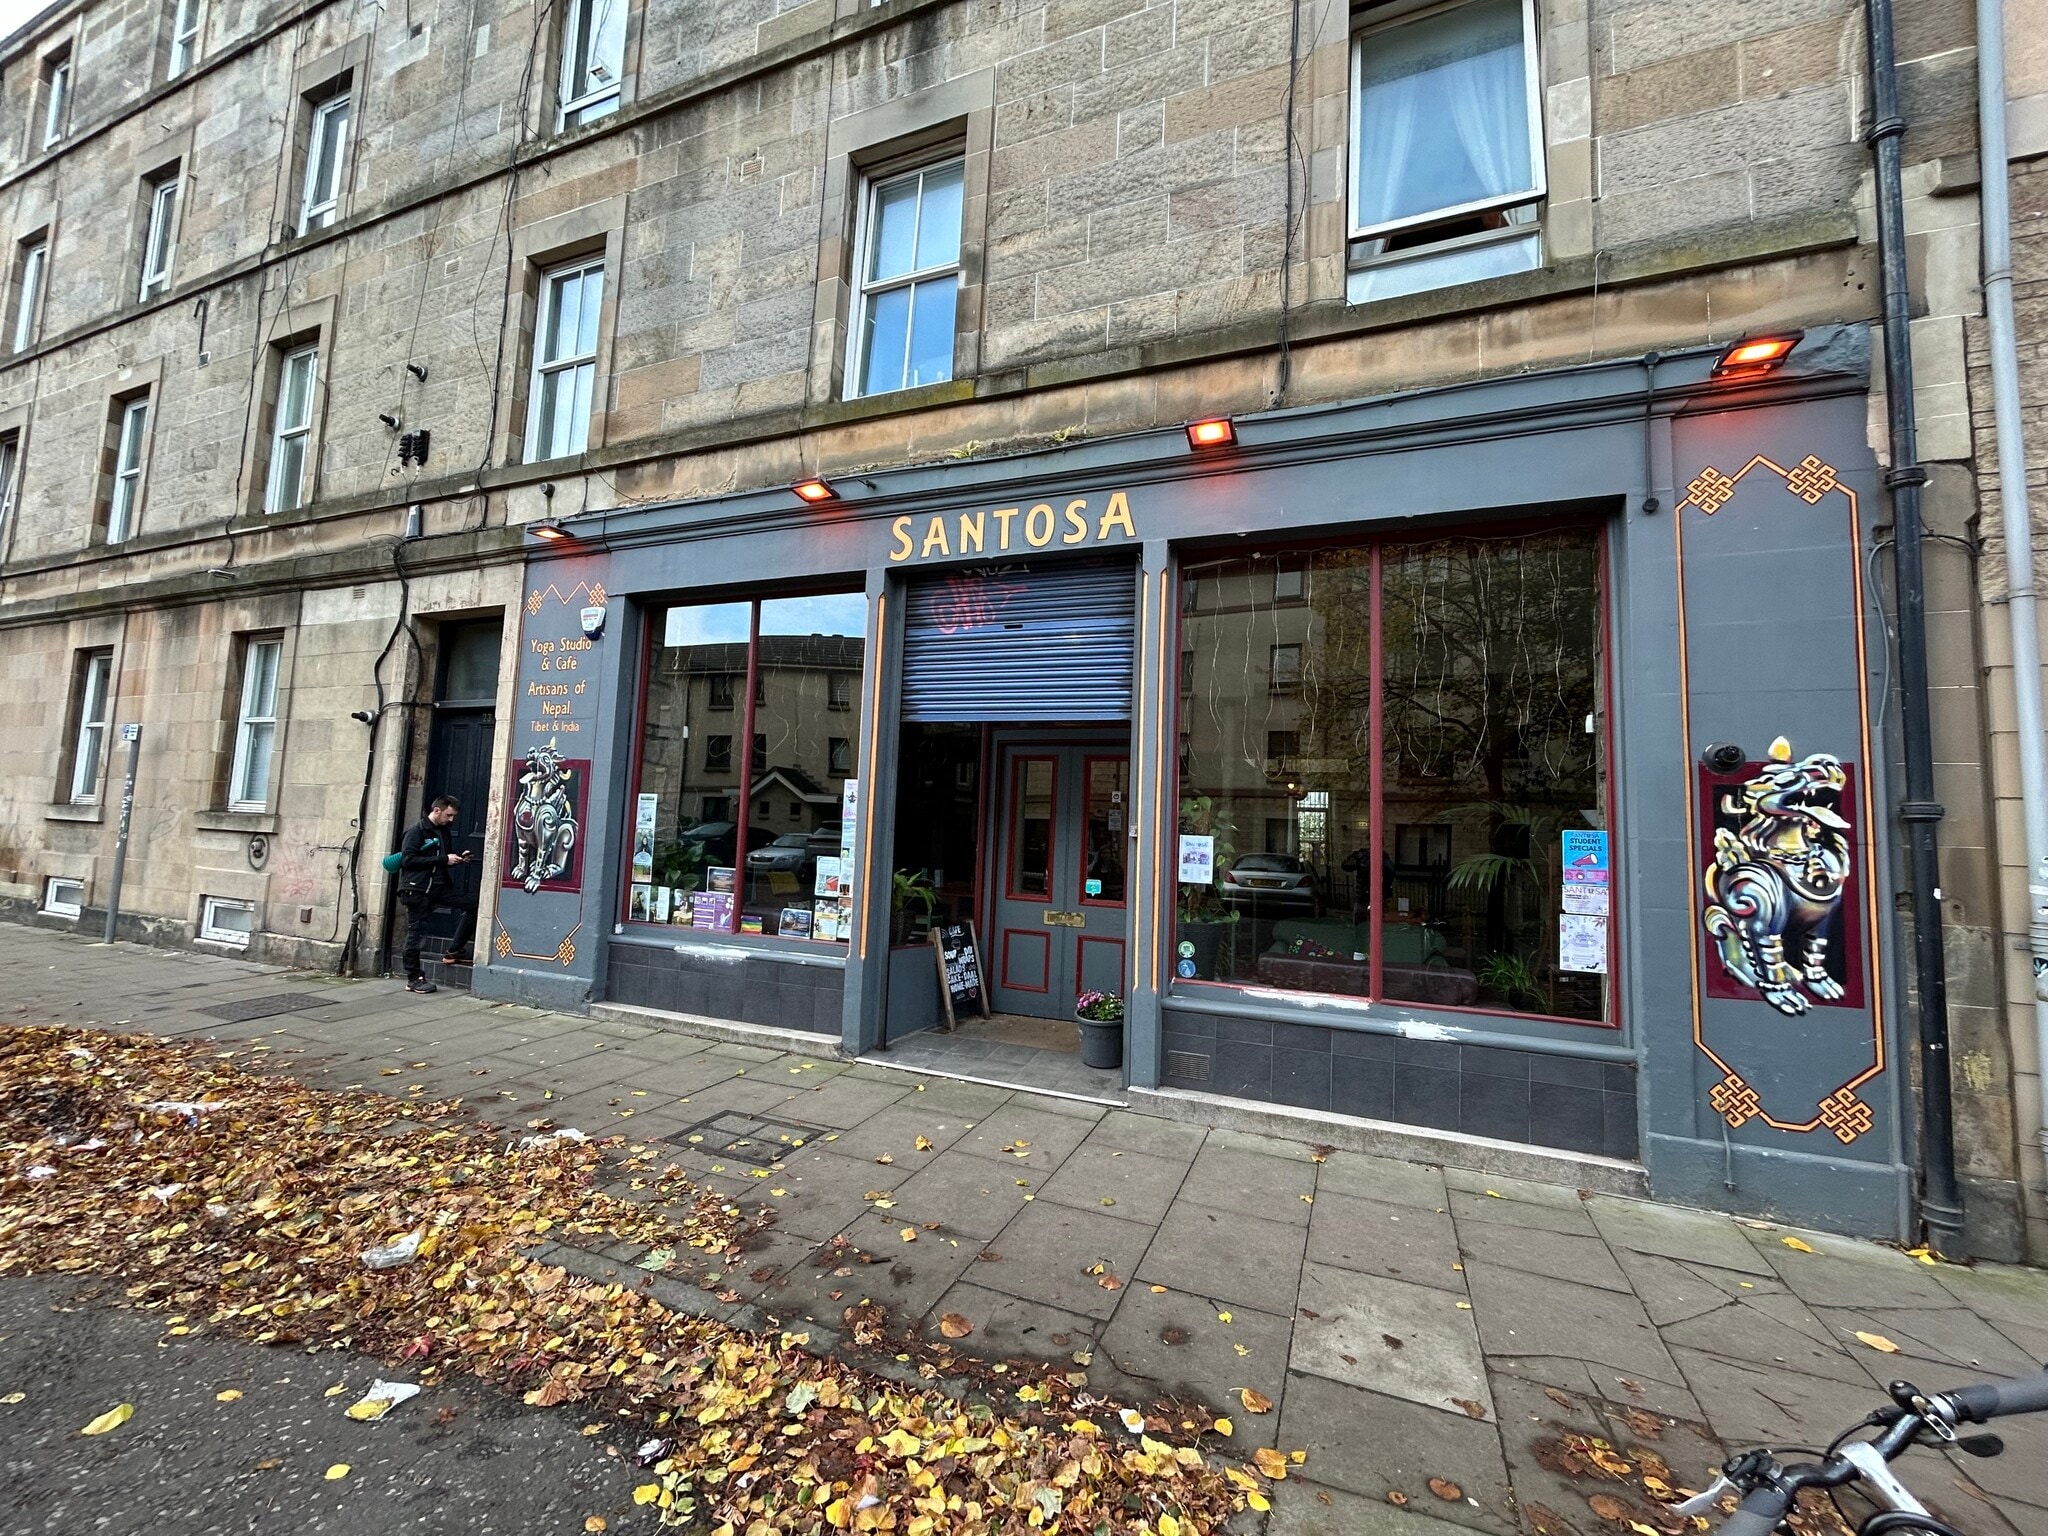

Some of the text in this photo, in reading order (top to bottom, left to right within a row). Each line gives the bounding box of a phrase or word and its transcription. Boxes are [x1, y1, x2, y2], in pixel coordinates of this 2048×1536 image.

[889, 492, 1136, 562] SANTOSA
[531, 636, 592, 655] Yoga Studio
[541, 658, 550, 671] &
[528, 679, 586, 696] Artisans of
[530, 719, 580, 733] Tibet & India
